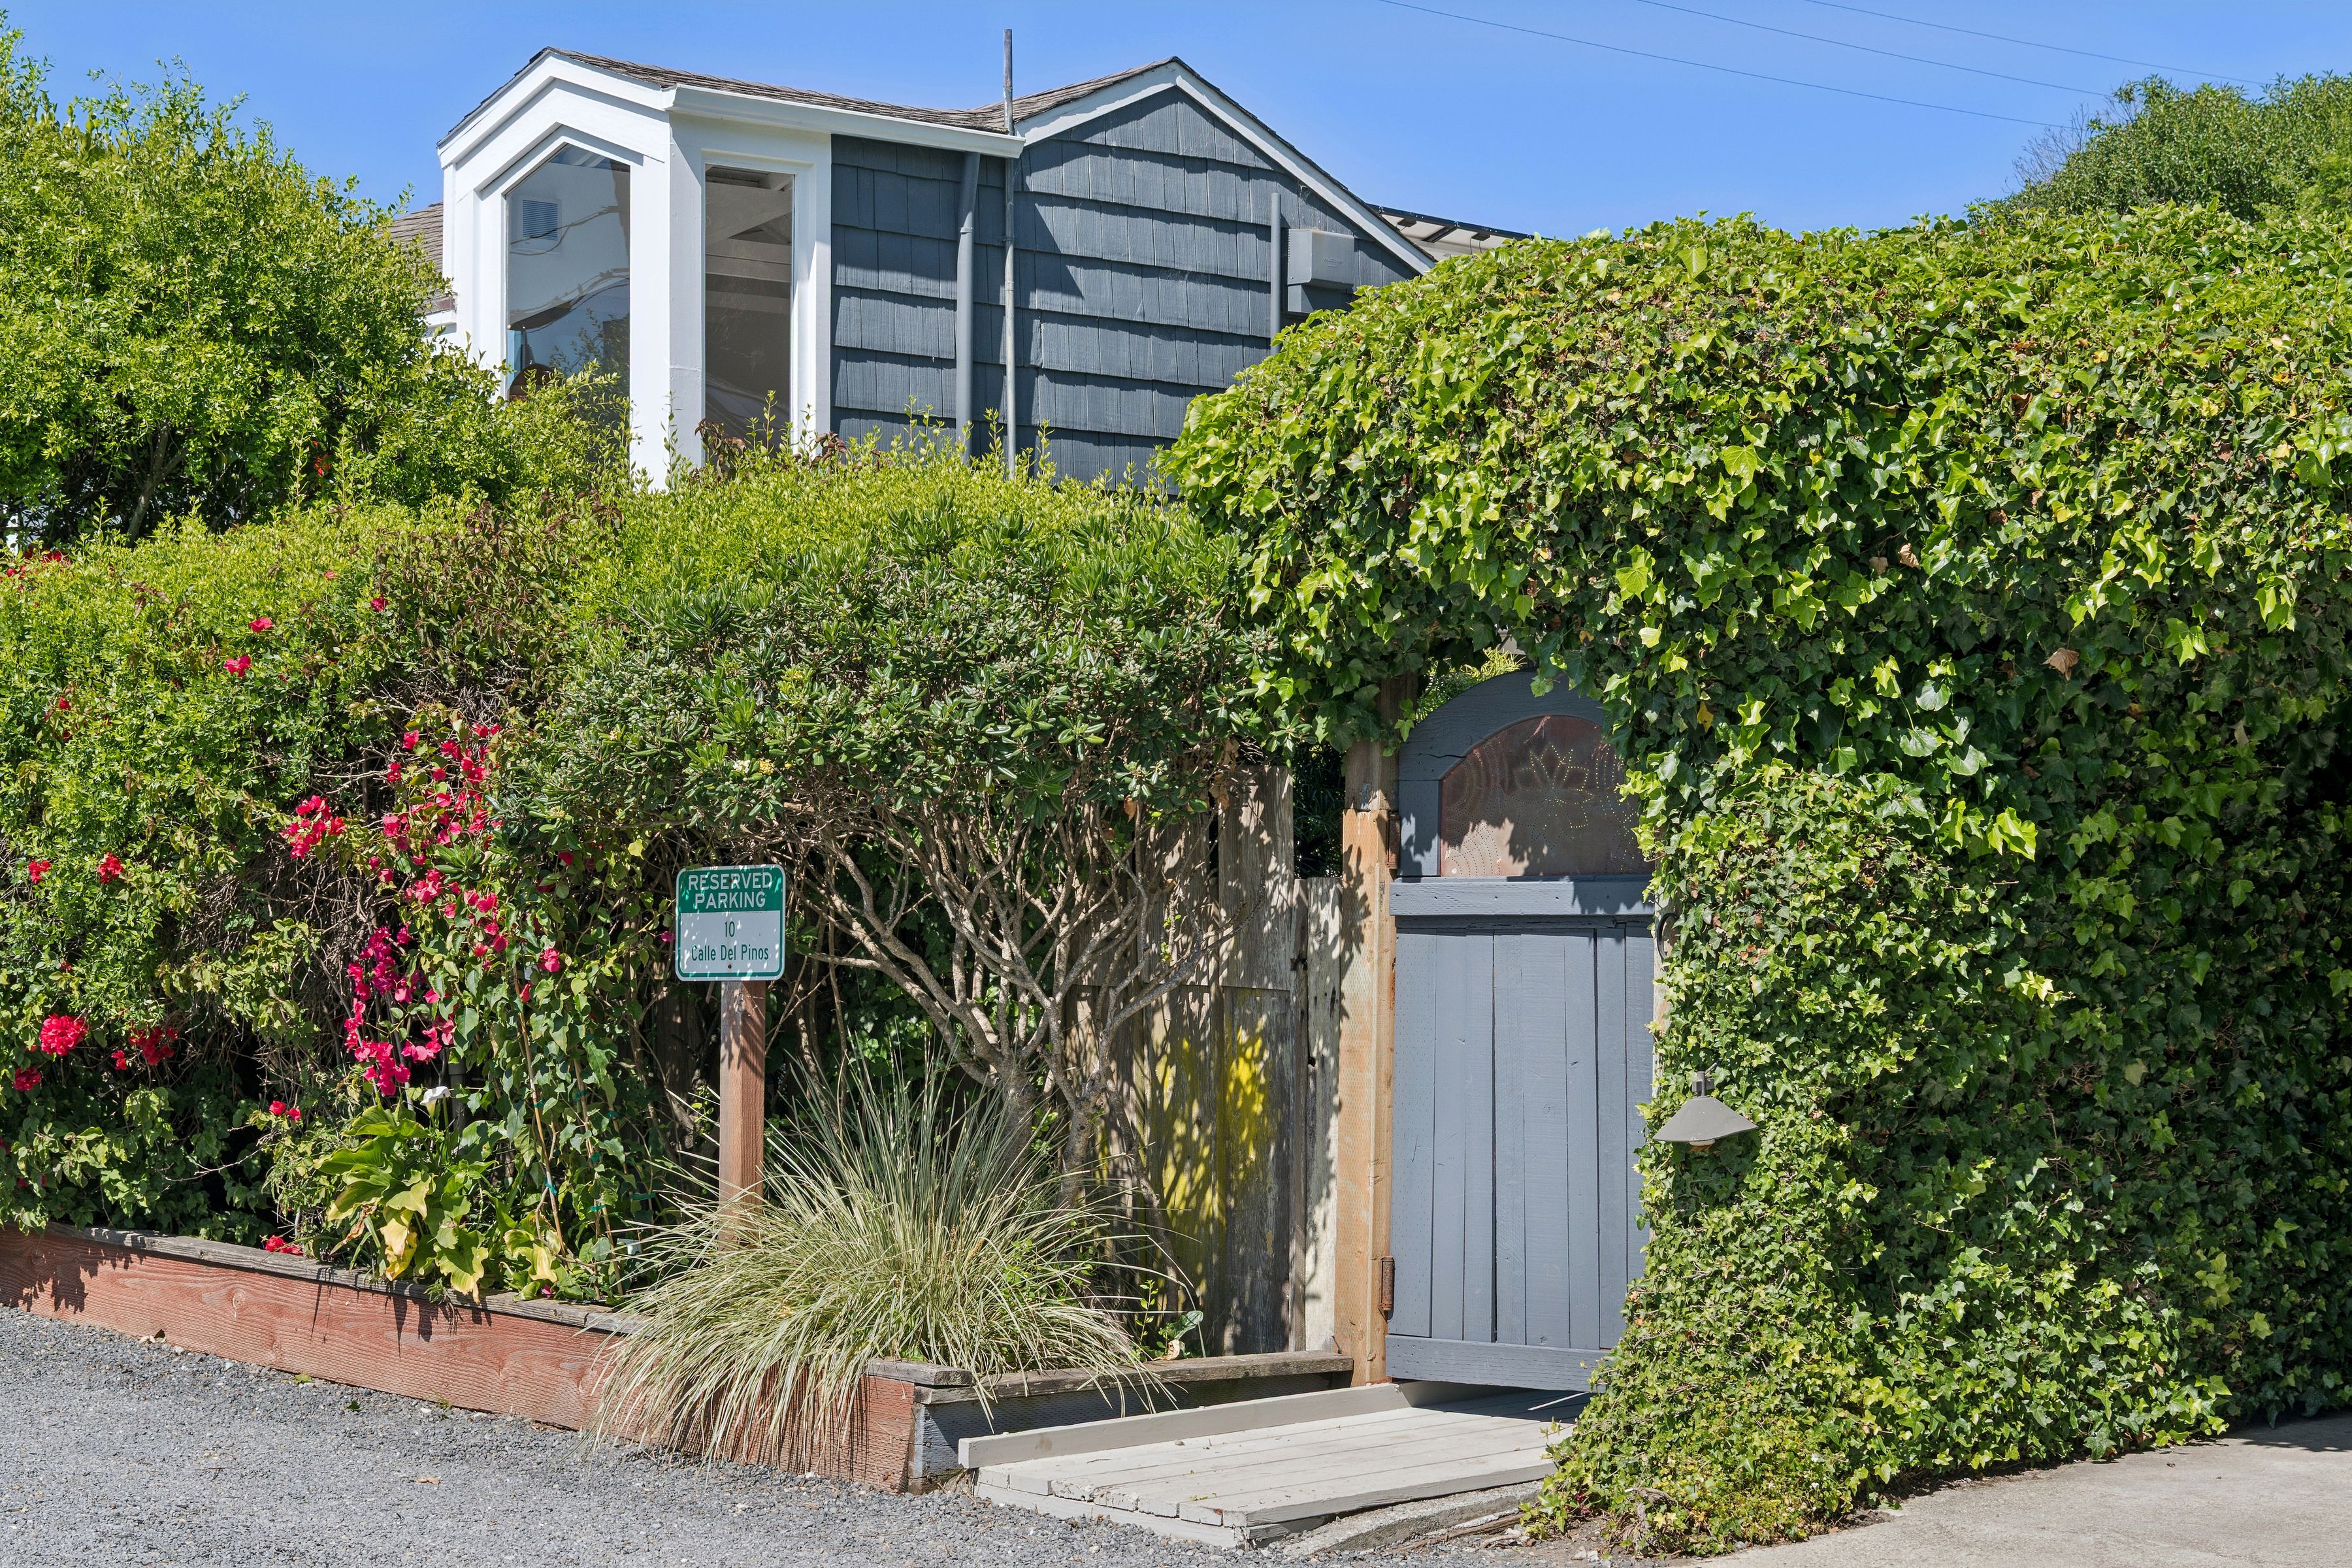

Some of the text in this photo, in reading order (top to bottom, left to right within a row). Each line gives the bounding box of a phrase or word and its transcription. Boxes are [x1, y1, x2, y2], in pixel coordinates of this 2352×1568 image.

[689, 872, 772, 890] RESERVED
[694, 891, 766, 909] PARKING
[725, 921, 735, 937] 10
[691, 944, 769, 961] Calle Del Pinos
